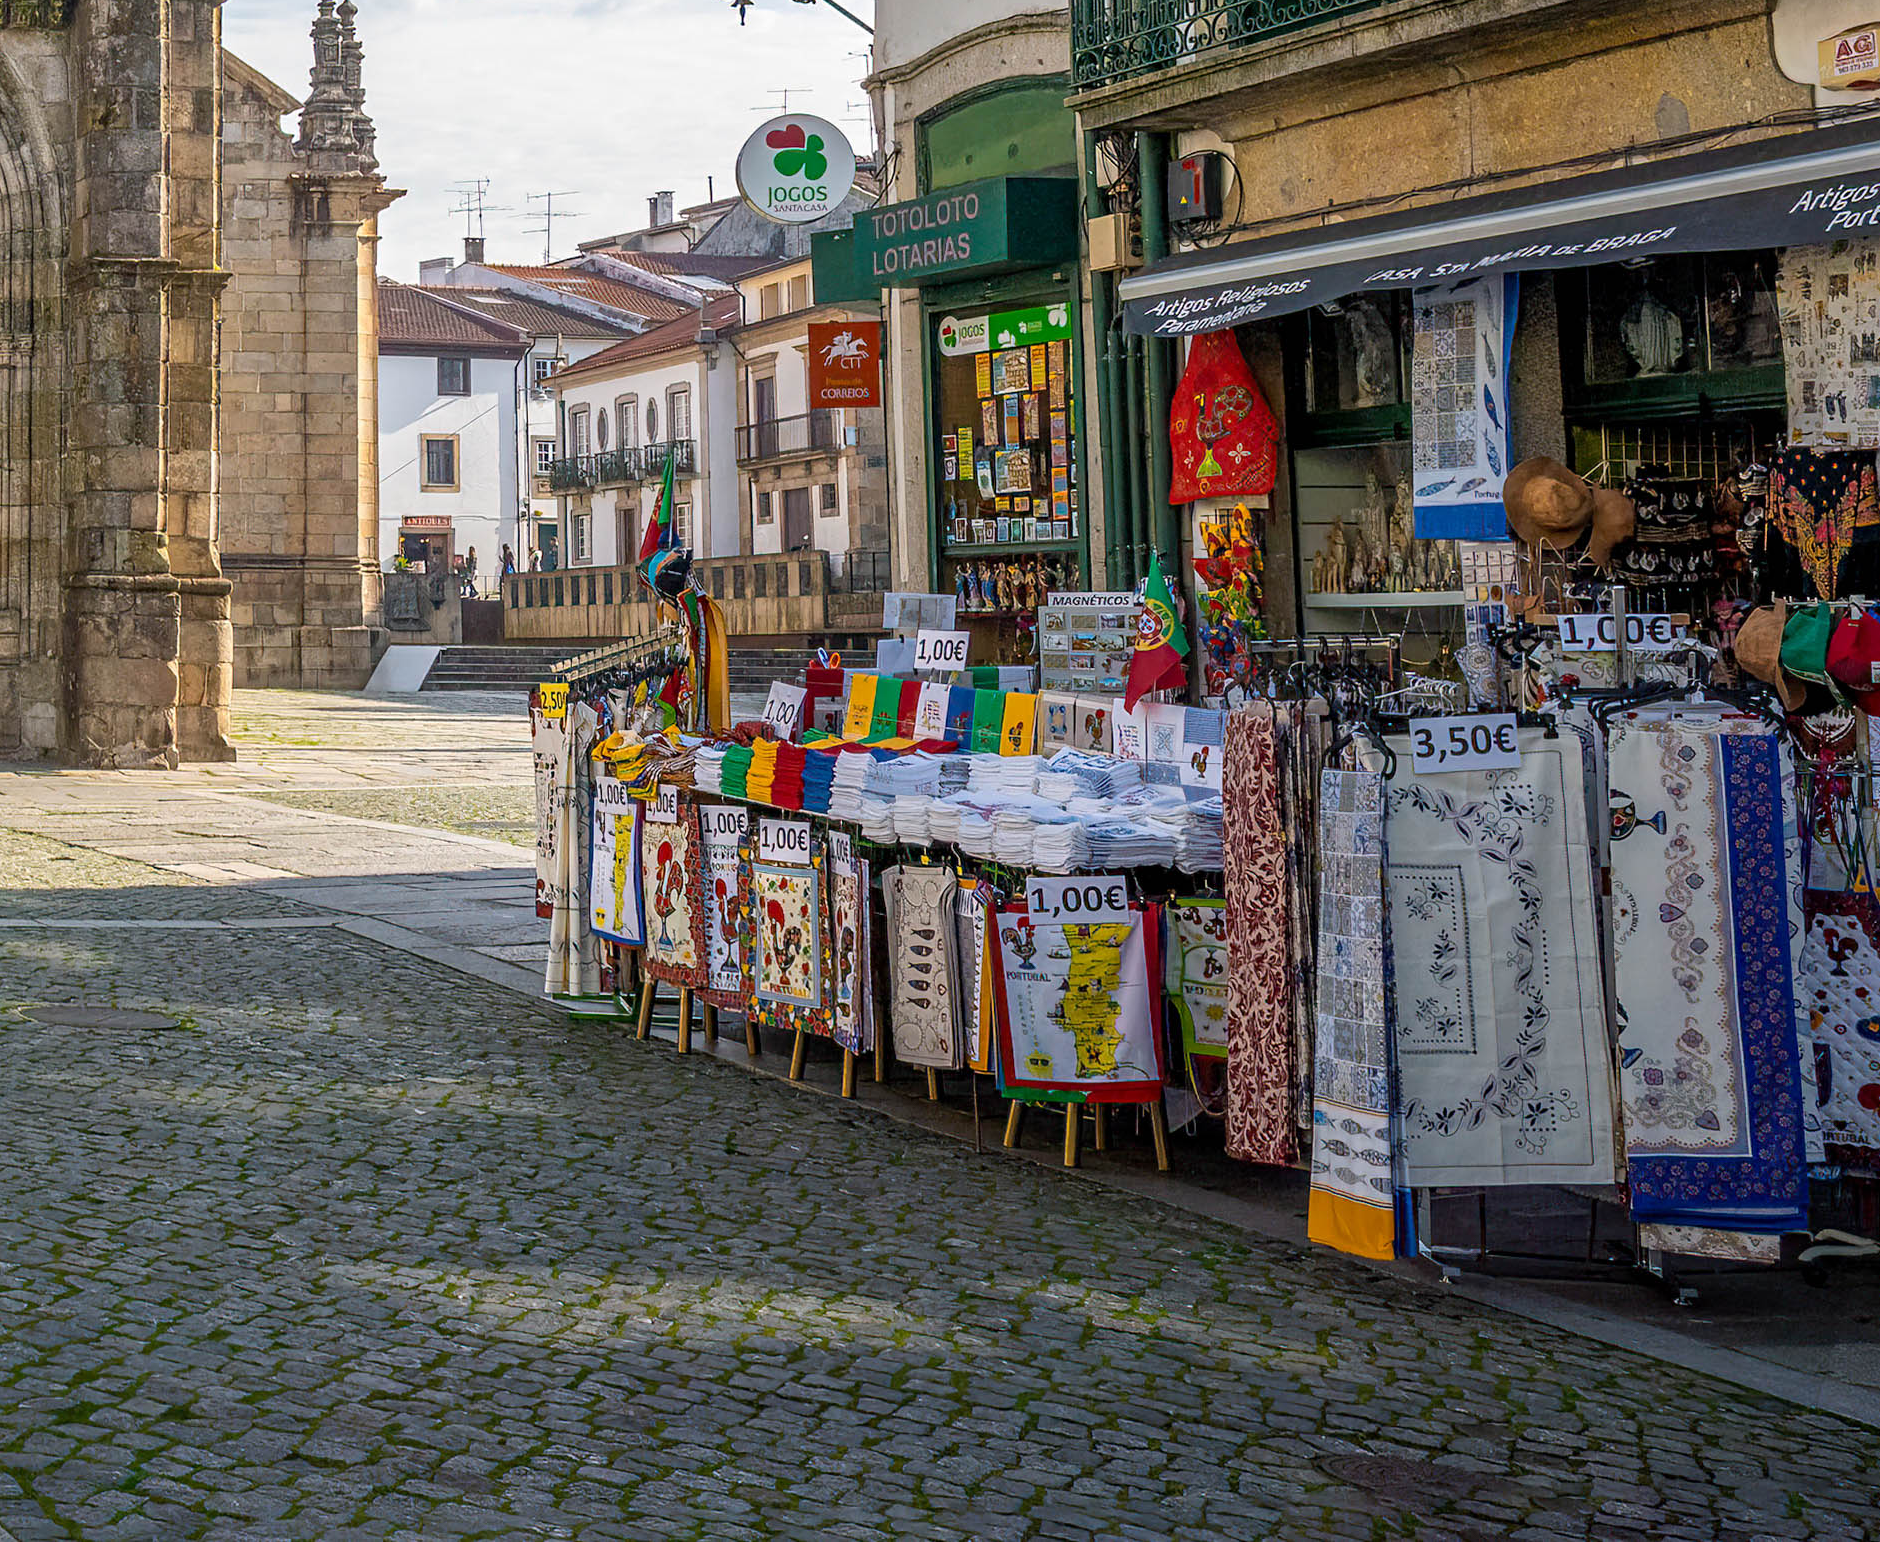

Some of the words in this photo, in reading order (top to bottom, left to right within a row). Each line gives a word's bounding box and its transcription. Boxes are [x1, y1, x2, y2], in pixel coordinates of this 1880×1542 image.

[767, 185, 828, 208] JOGOS
[872, 193, 979, 240] TOTOLOTO
[873, 232, 971, 276] LOTARIAS
[1551, 243, 1583, 257] DE
[1581, 226, 1678, 254] BRAGA
[1144, 297, 1213, 318] Artigos
[1215, 279, 1312, 308] Religiosos
[821, 387, 870, 399] CORREIOS
[1052, 593, 1131, 607] MAGNÉTICOS
[916, 638, 966, 664] 1,00€
[765, 699, 795, 725] 1,00
[1414, 723, 1518, 764] 3,50€
[598, 782, 627, 808] 1,00€
[703, 811, 749, 838] 1,00€
[760, 824, 809, 853] 1,00€
[1030, 884, 1126, 918] 1,00€
[1006, 971, 1051, 982] PORTUGAL
